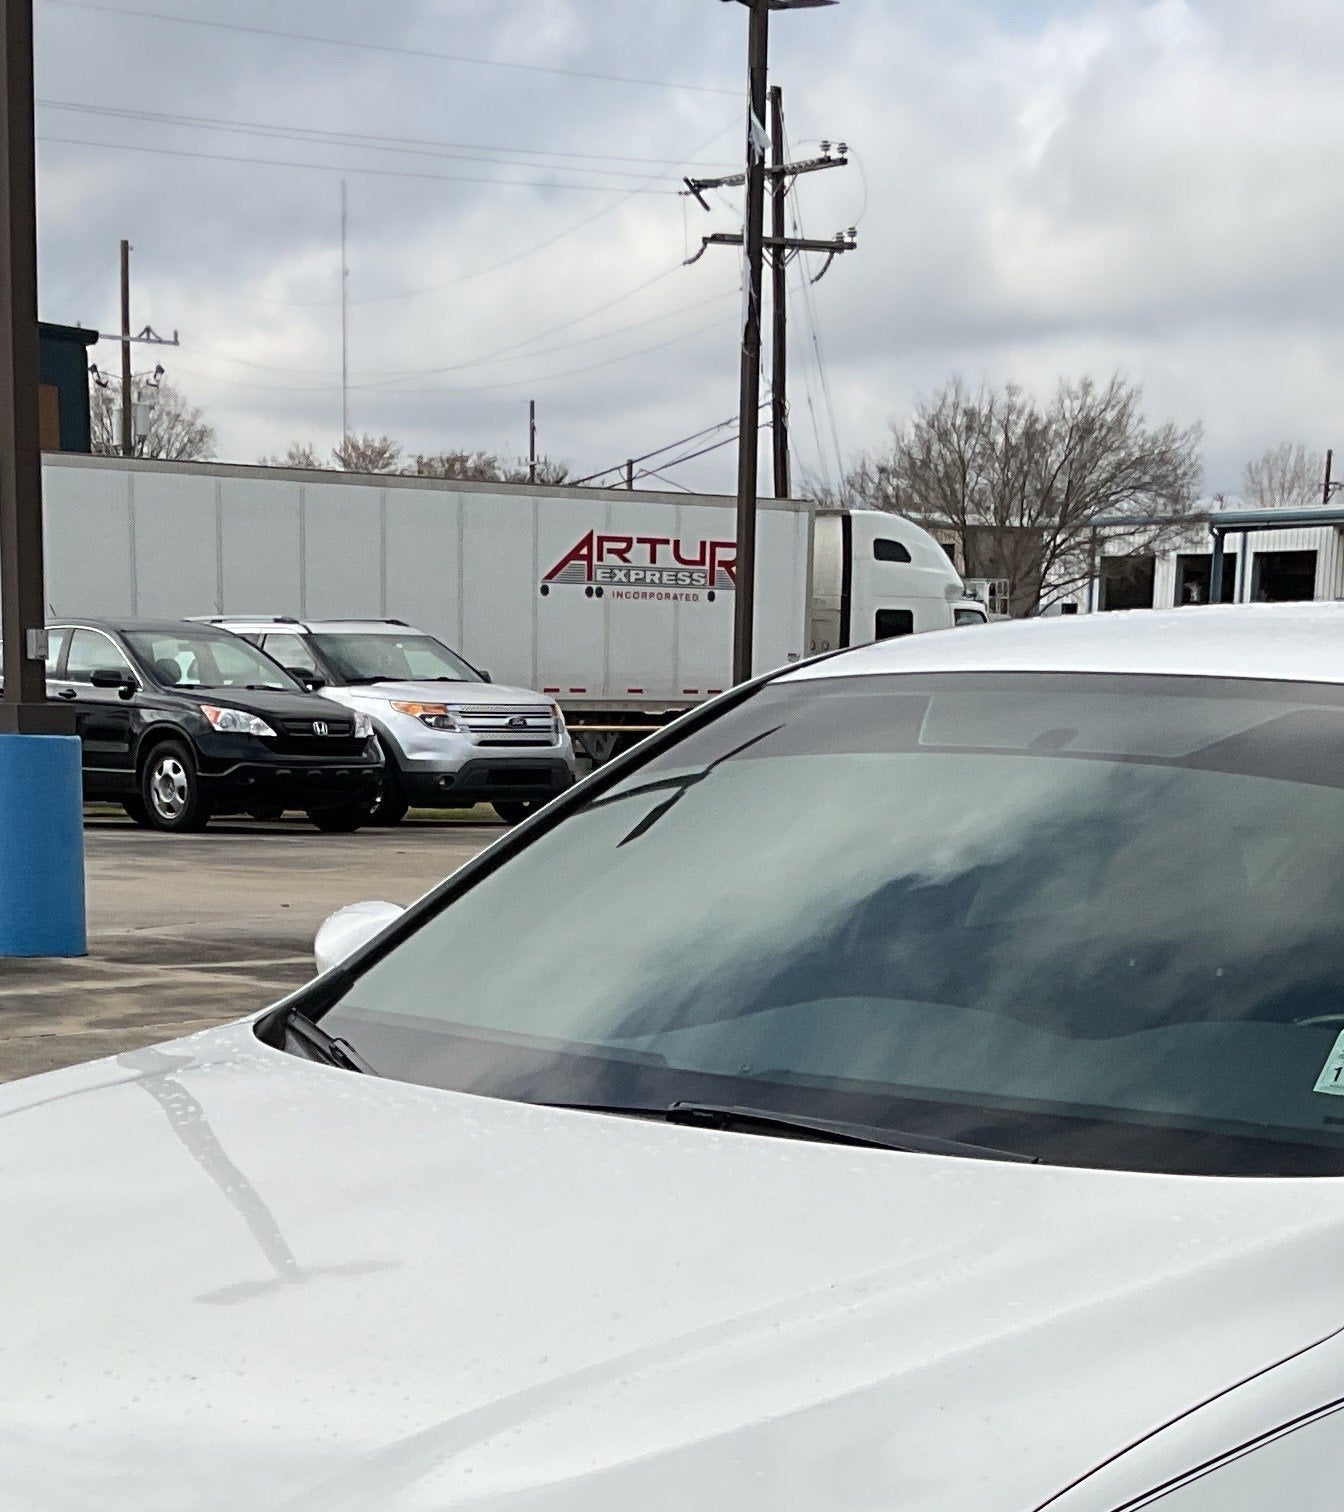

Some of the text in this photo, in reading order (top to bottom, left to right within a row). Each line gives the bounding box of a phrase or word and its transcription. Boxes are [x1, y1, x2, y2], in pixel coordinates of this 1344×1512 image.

[542, 529, 737, 587] ARTUR
[596, 568, 706, 586] EXPRESS
[612, 590, 699, 602] INCORPORATED
